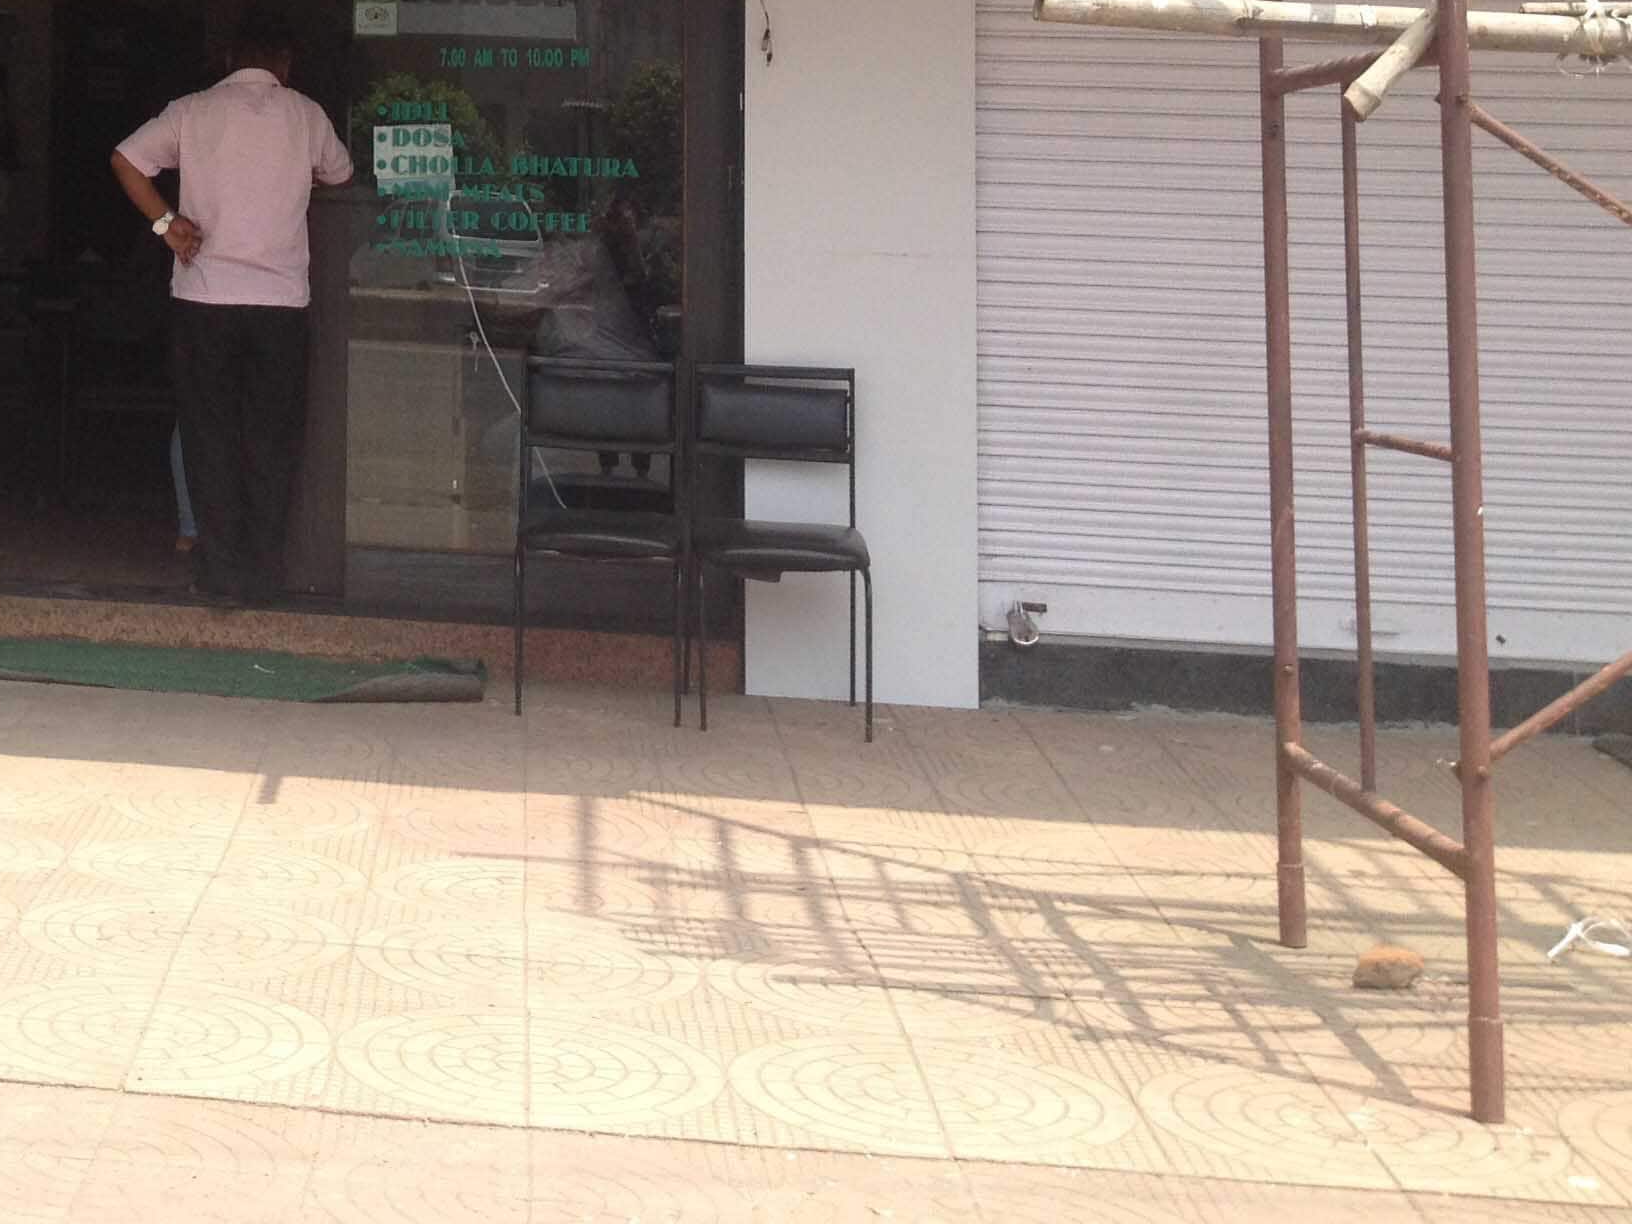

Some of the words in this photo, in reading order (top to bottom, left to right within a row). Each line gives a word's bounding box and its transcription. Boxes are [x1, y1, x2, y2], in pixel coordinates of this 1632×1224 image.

[474, 47, 494, 68] AM
[501, 47, 518, 67] TO
[571, 47, 591, 68] PM
[391, 127, 465, 148] DOSA
[390, 154, 496, 176] CHOLLA
[512, 155, 641, 177] BHATURA
[390, 209, 480, 231] FILTER
[490, 211, 592, 233] COFFEE
